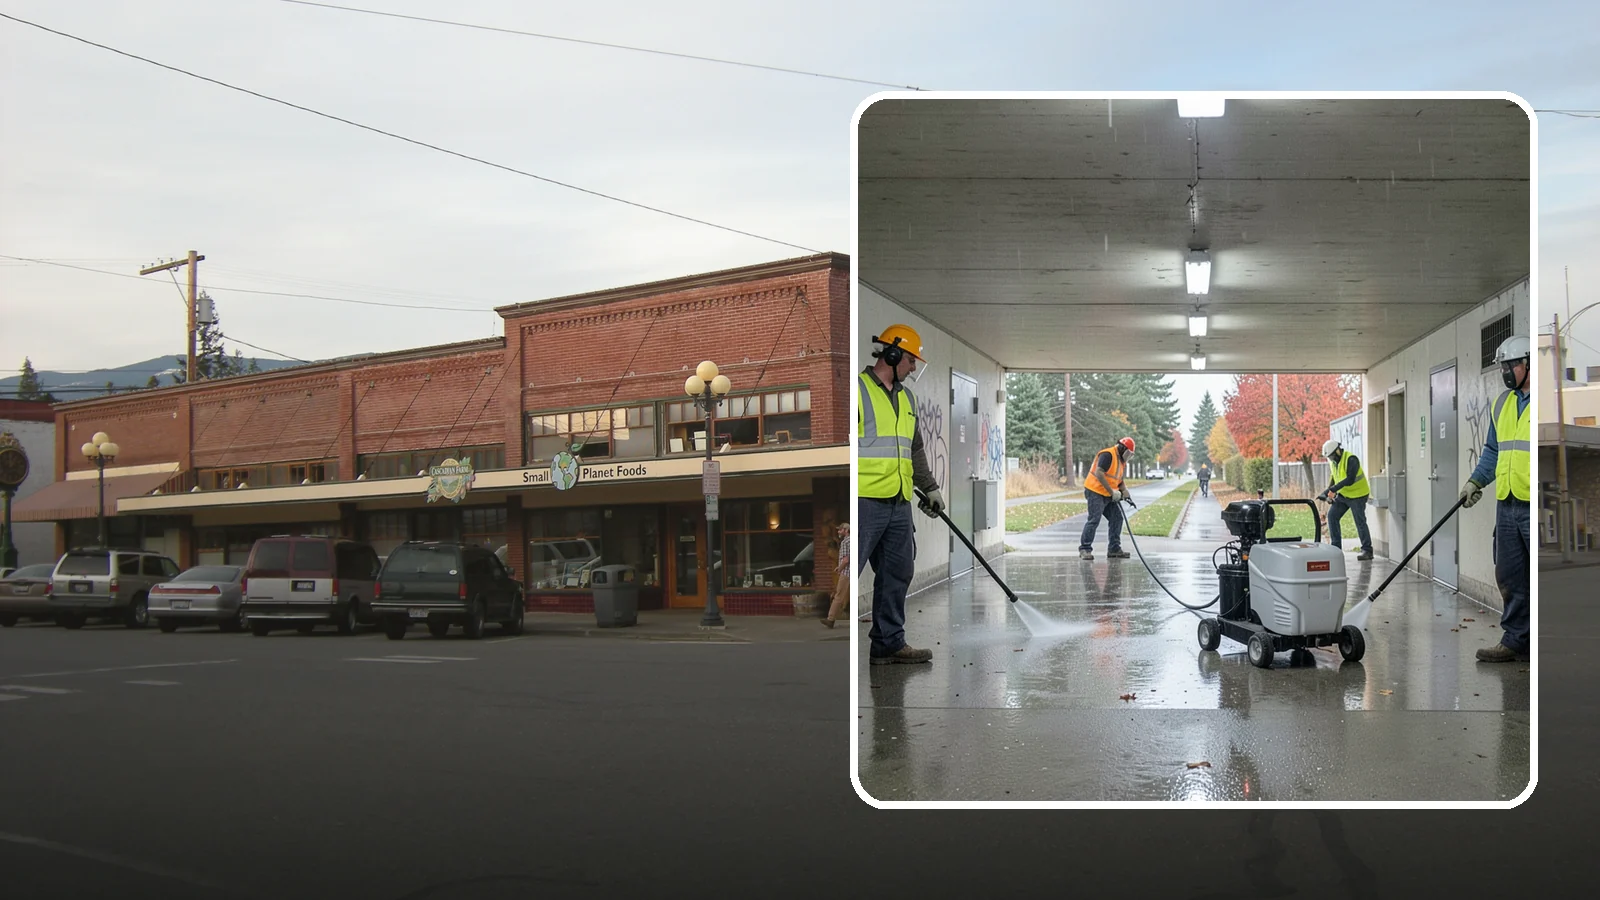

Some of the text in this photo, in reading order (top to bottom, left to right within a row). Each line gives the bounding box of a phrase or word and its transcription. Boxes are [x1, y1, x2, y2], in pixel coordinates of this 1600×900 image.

[523, 464, 647, 483] Small Planet Foods
